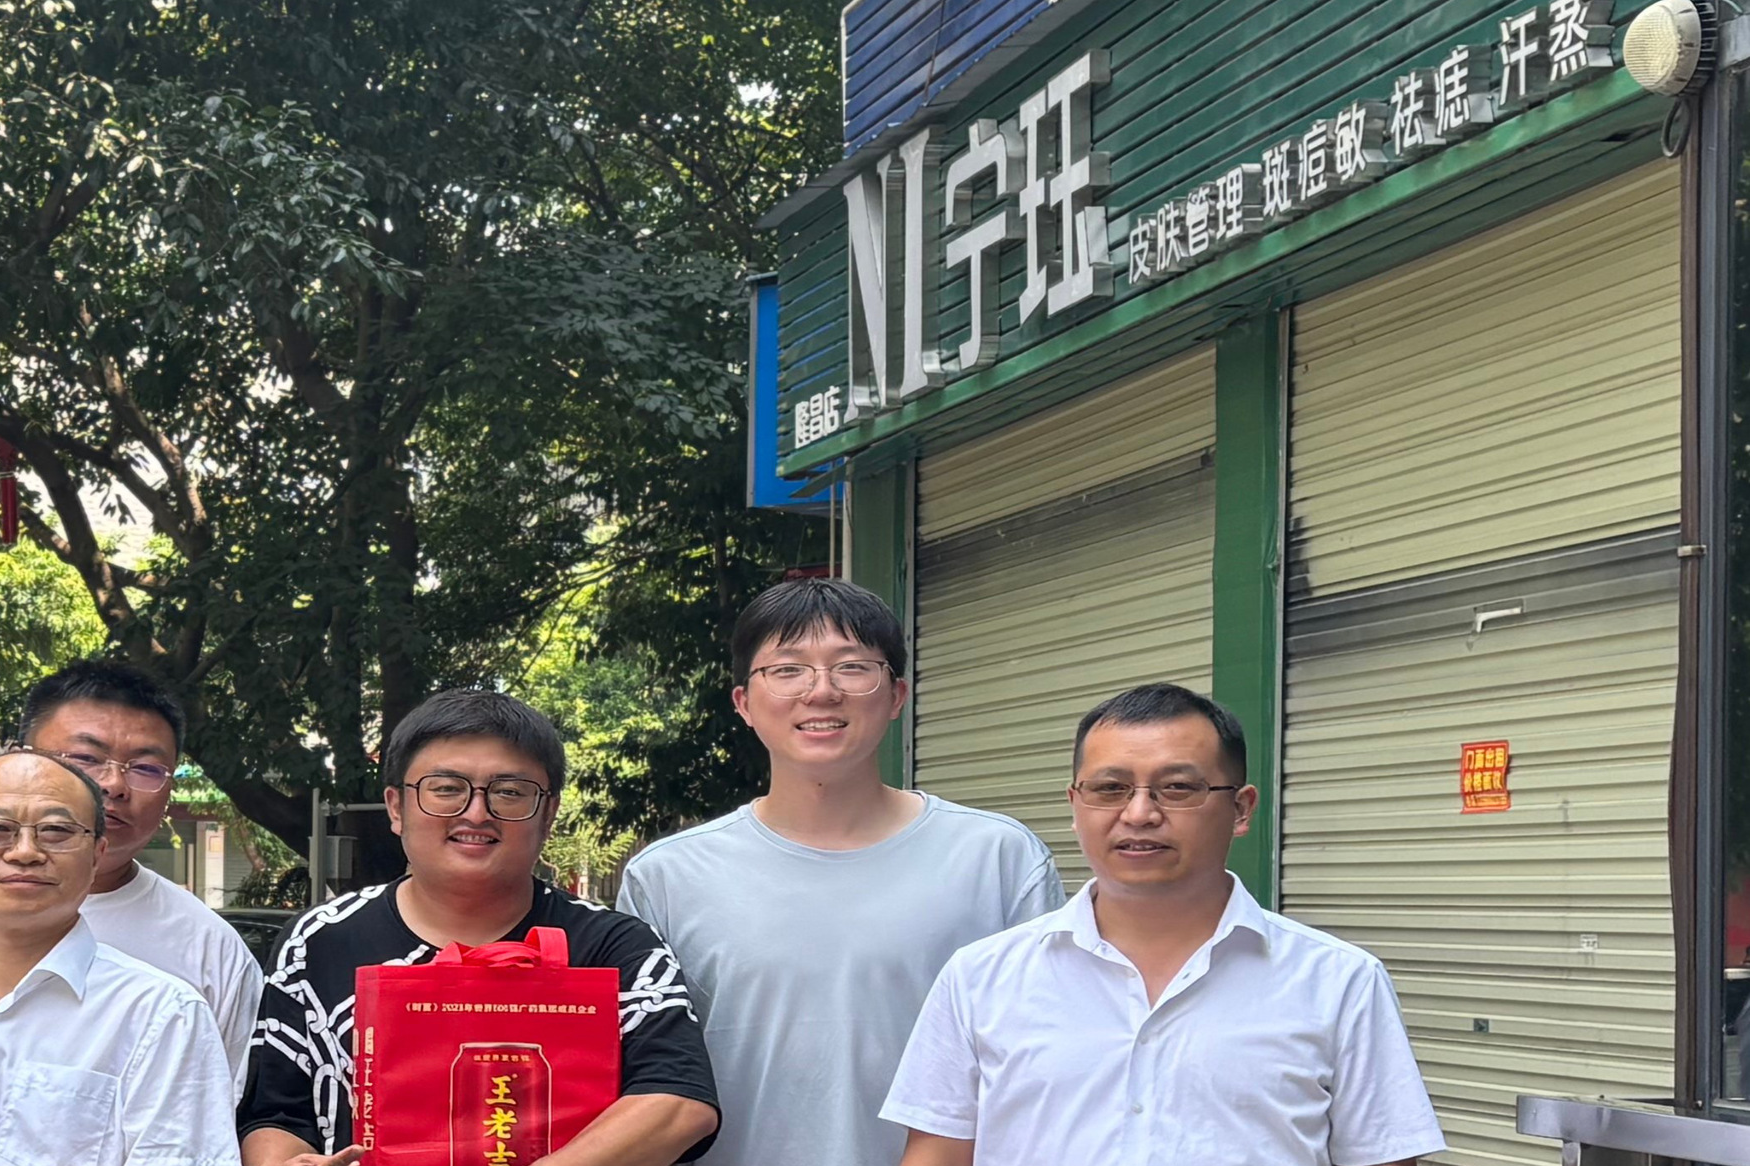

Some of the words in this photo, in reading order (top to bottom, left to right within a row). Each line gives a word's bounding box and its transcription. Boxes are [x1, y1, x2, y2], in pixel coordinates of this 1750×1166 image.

[1129, 165, 1244, 285] 皮肤管理
[1262, 101, 1368, 217] 斑痘敏
[1391, 45, 1470, 156] 祛痣
[1499, 0, 1589, 106] 汗蒸
[795, 386, 840, 449] 隆昌店
